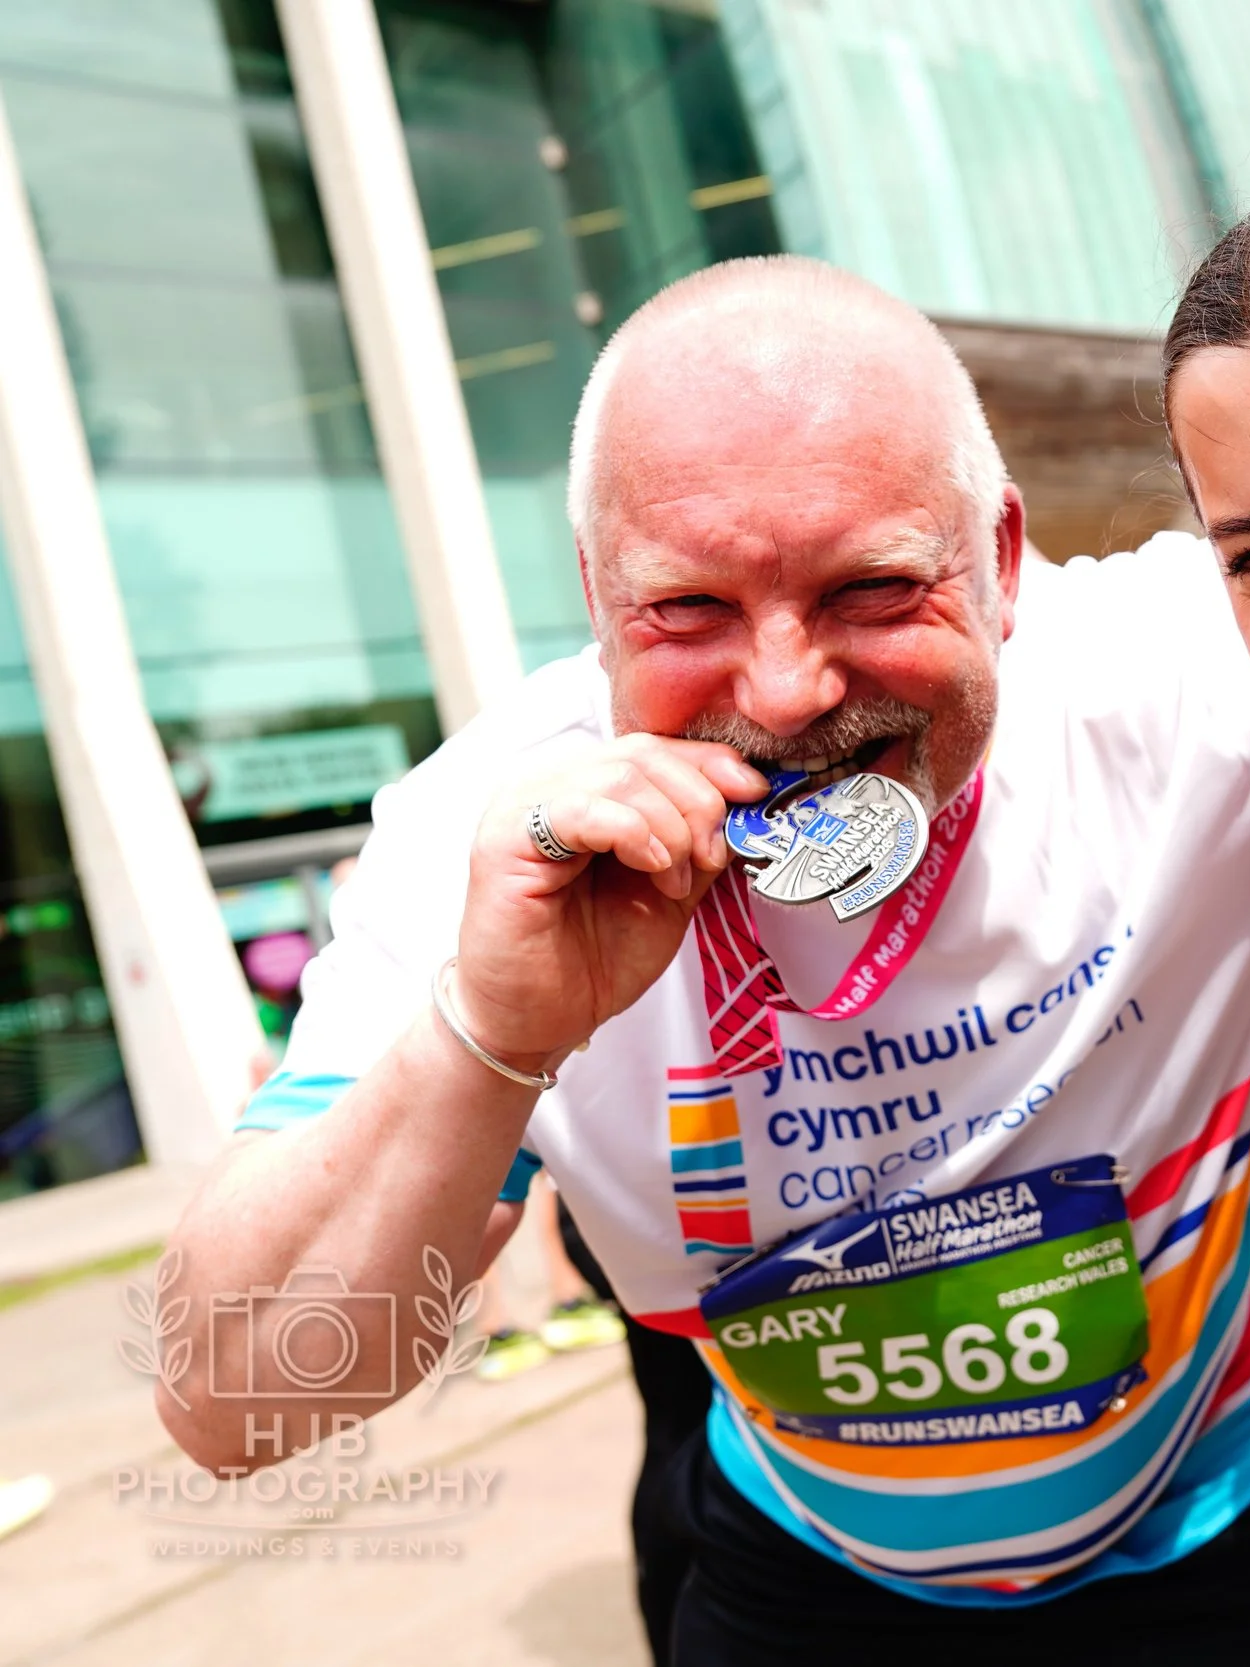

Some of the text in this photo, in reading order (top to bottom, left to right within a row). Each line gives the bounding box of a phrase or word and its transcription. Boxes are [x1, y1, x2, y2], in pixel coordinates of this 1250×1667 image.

[809, 802, 892, 881] SWANSEA
[841, 819, 915, 911] #RUNSWANSEA
[865, 840, 895, 866] 2026
[835, 963, 878, 1014] Half
[874, 841, 948, 968] Marathon
[762, 1006, 996, 1097] ymchwil
[767, 1089, 942, 1153] cymru
[779, 1122, 957, 1210] cancer
[890, 1181, 1039, 1242] SWANSEA
[895, 1231, 944, 1263] Half
[940, 1210, 1043, 1251] Marathon
[997, 1256, 1129, 1308] RESEARCH WALES
[1062, 1237, 1124, 1269] CANCER
[720, 1303, 848, 1348] GARY
[816, 1307, 1069, 1405] 5568
[838, 1400, 1085, 1444] #RUNSWANSEA
